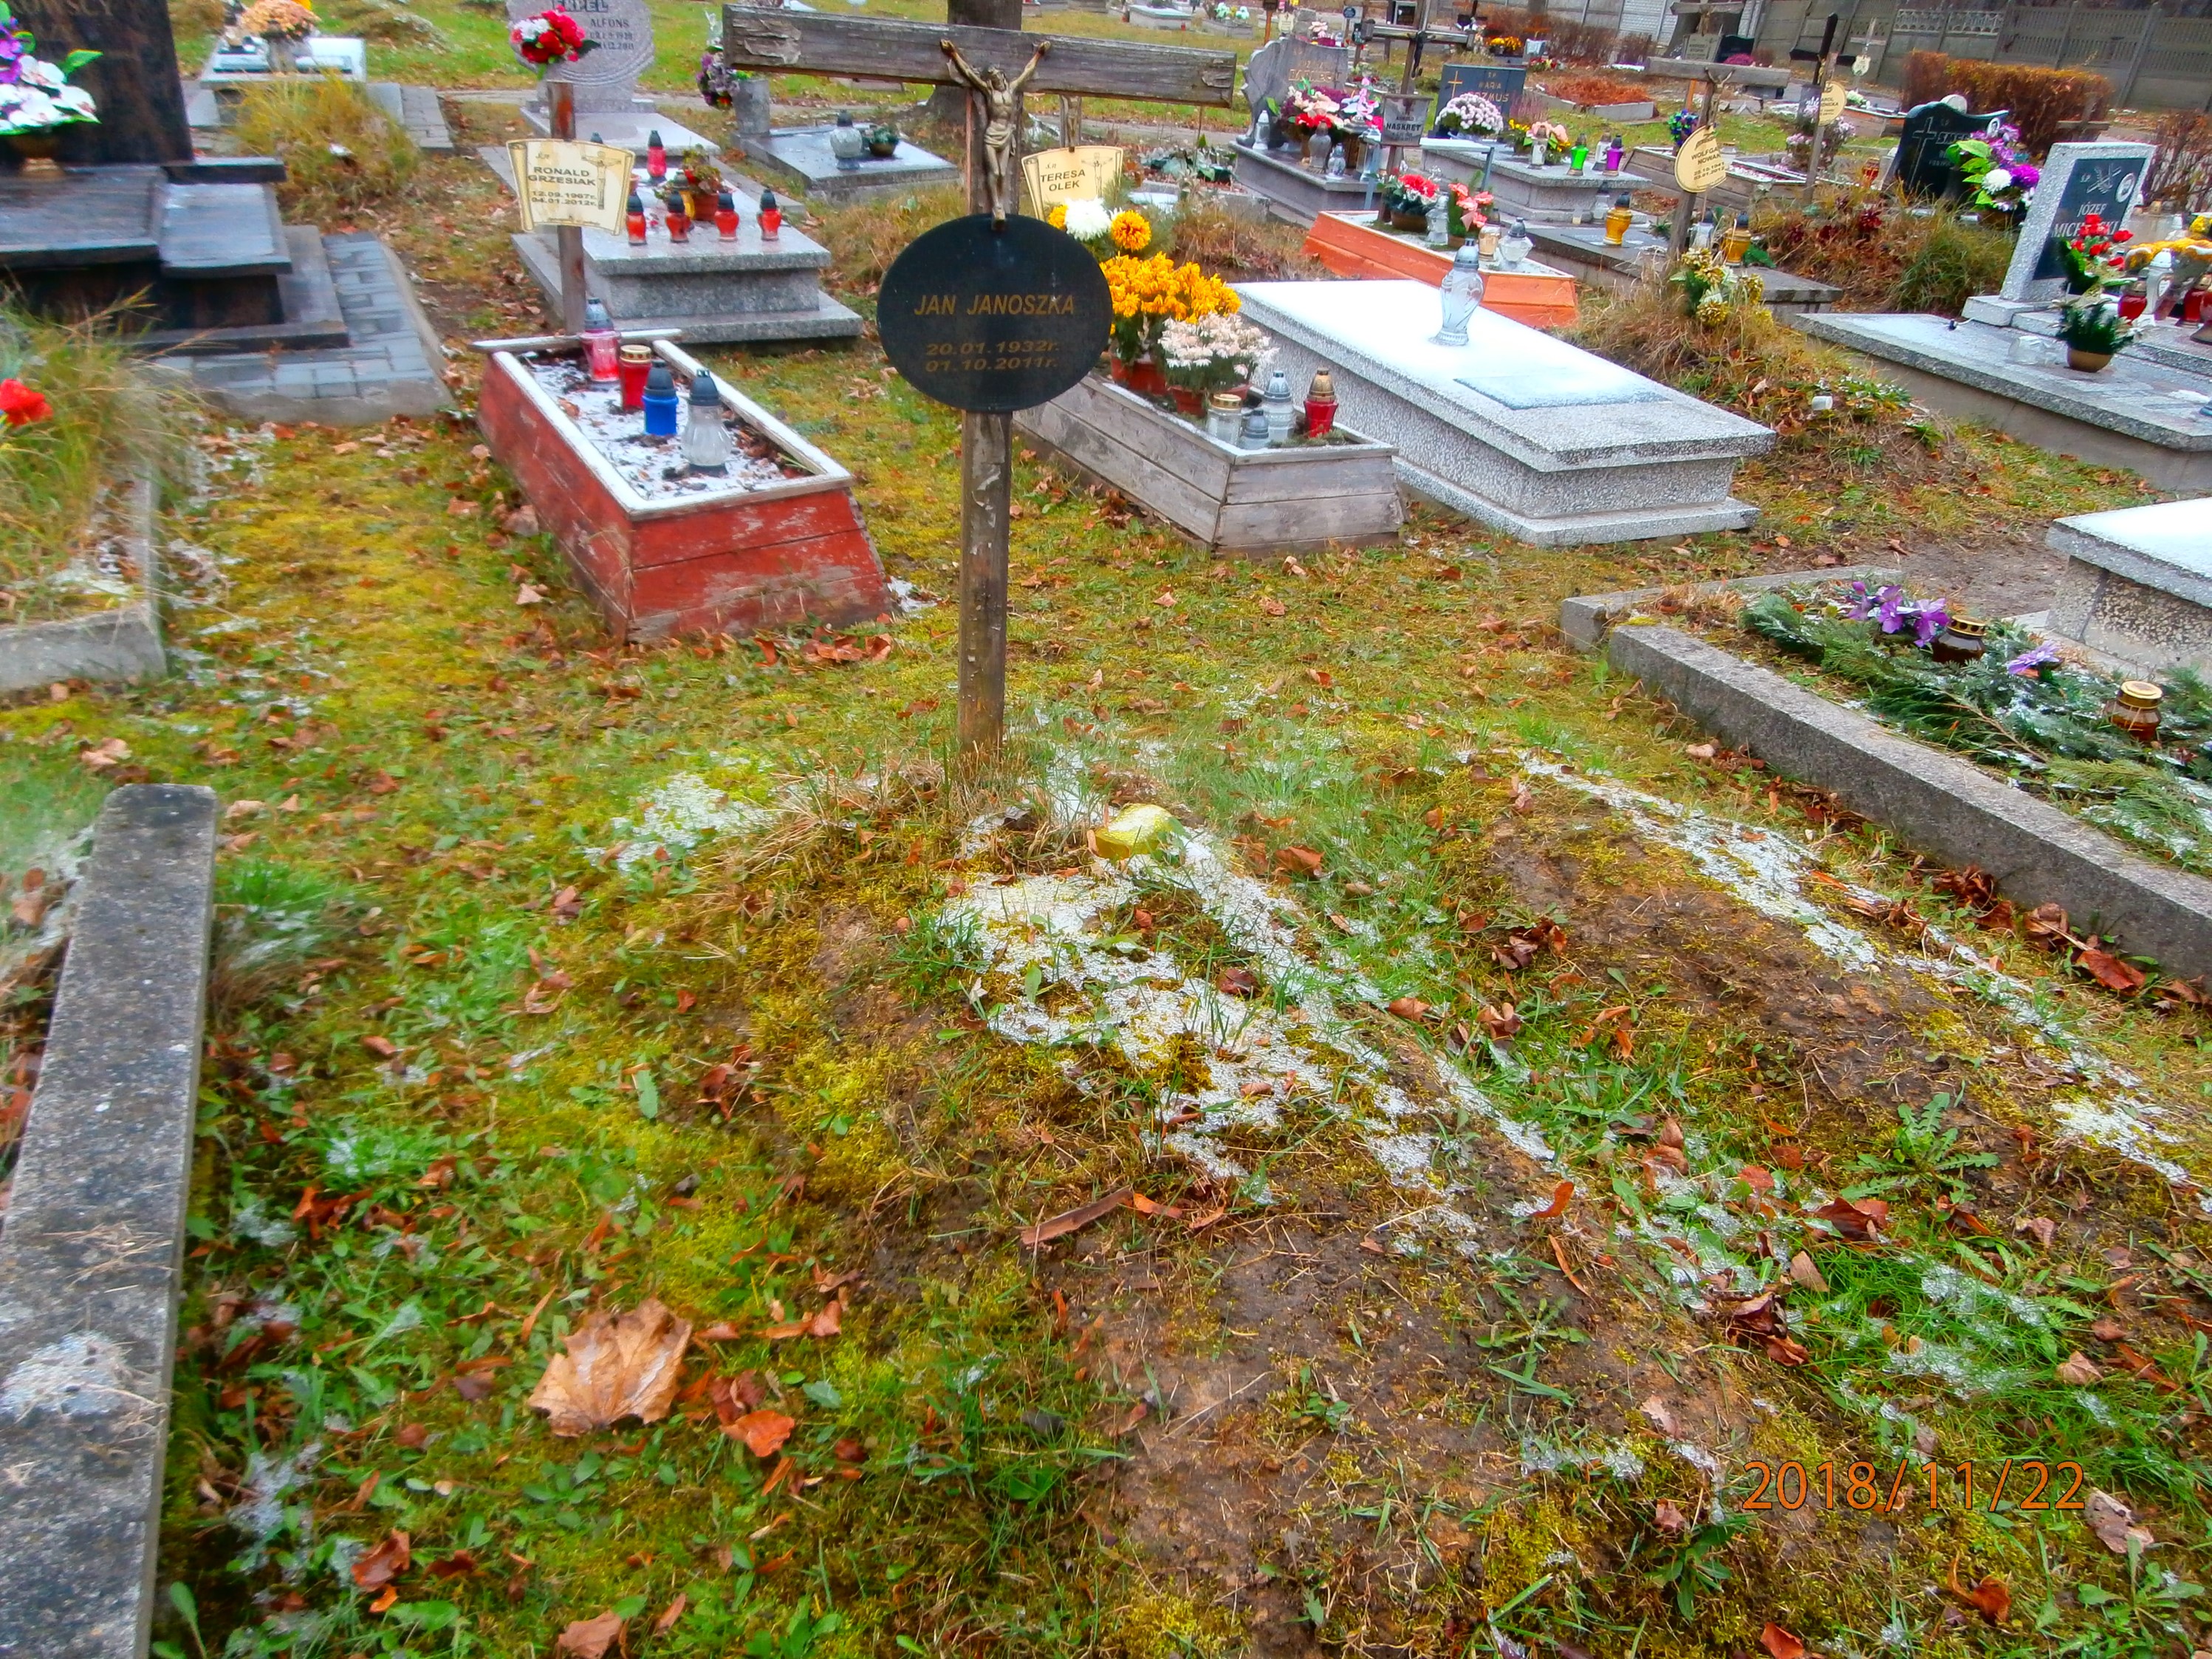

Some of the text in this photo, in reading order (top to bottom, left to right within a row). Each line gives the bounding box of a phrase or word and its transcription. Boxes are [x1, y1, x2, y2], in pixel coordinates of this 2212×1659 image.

[591, 18, 630, 27] ALFONS
[1386, 123, 1422, 131] NASKRET
[533, 166, 590, 177] RONALD
[1040, 169, 1086, 182] TERESA
[528, 174, 596, 186] GRZESIAK
[1049, 179, 1080, 191] OLEK
[2076, 201, 2108, 218] JÓZEF
[914, 293, 1075, 315] JAN JANOSZKA
